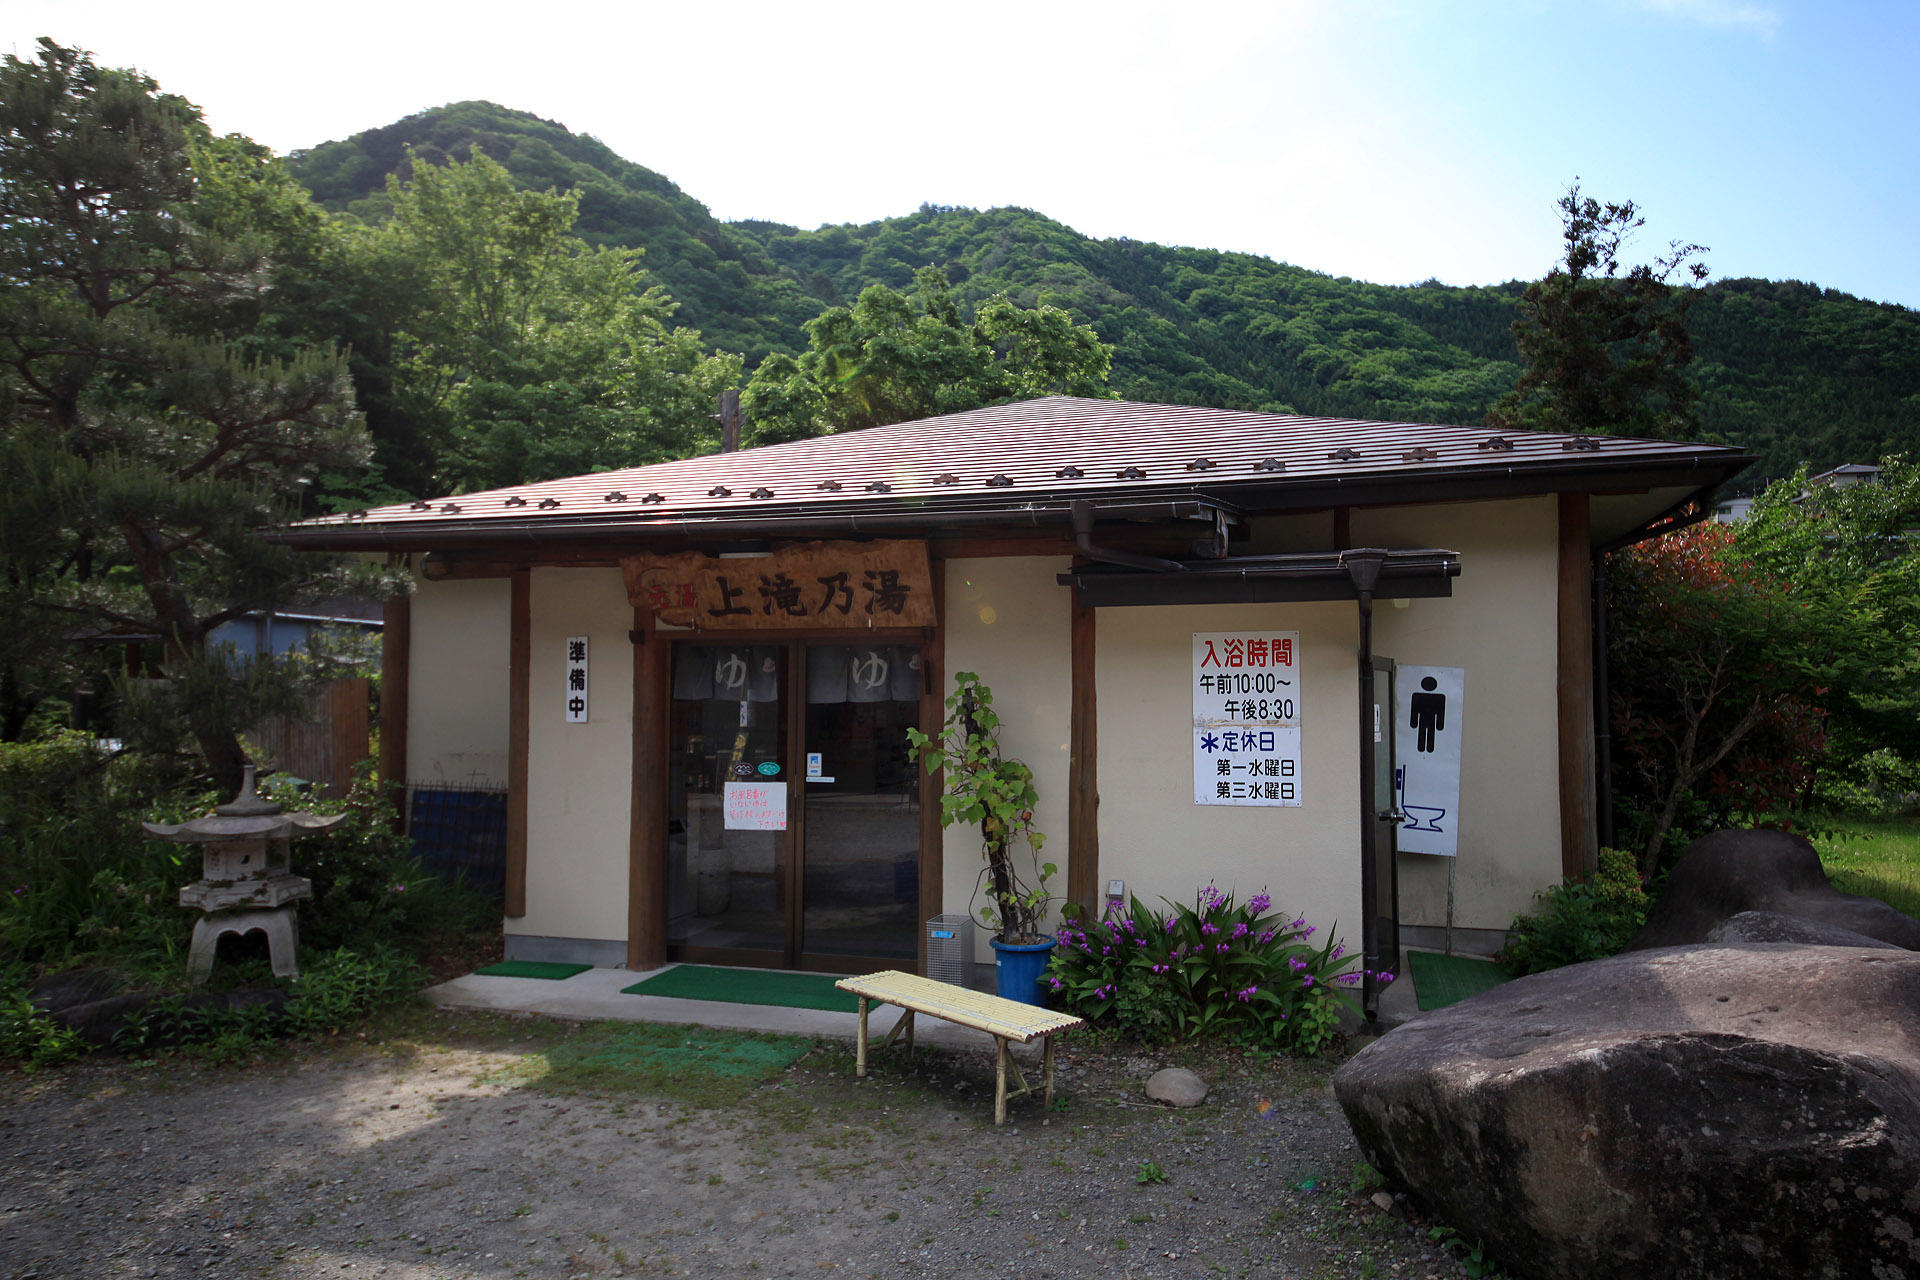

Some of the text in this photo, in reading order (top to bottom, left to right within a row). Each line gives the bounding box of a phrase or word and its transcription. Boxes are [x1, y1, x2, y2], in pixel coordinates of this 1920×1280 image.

[708, 570, 911, 617] 上滝乃湯
[1200, 638, 1293, 668] 入浴時間
[568, 640, 586, 719] 準備中
[715, 652, 747, 690] ゆ
[852, 651, 888, 690] ゆ
[1224, 698, 1294, 720] 午後8:30
[1216, 758, 1295, 777] 第一水曜日
[1216, 780, 1295, 800] 第三水曜日
